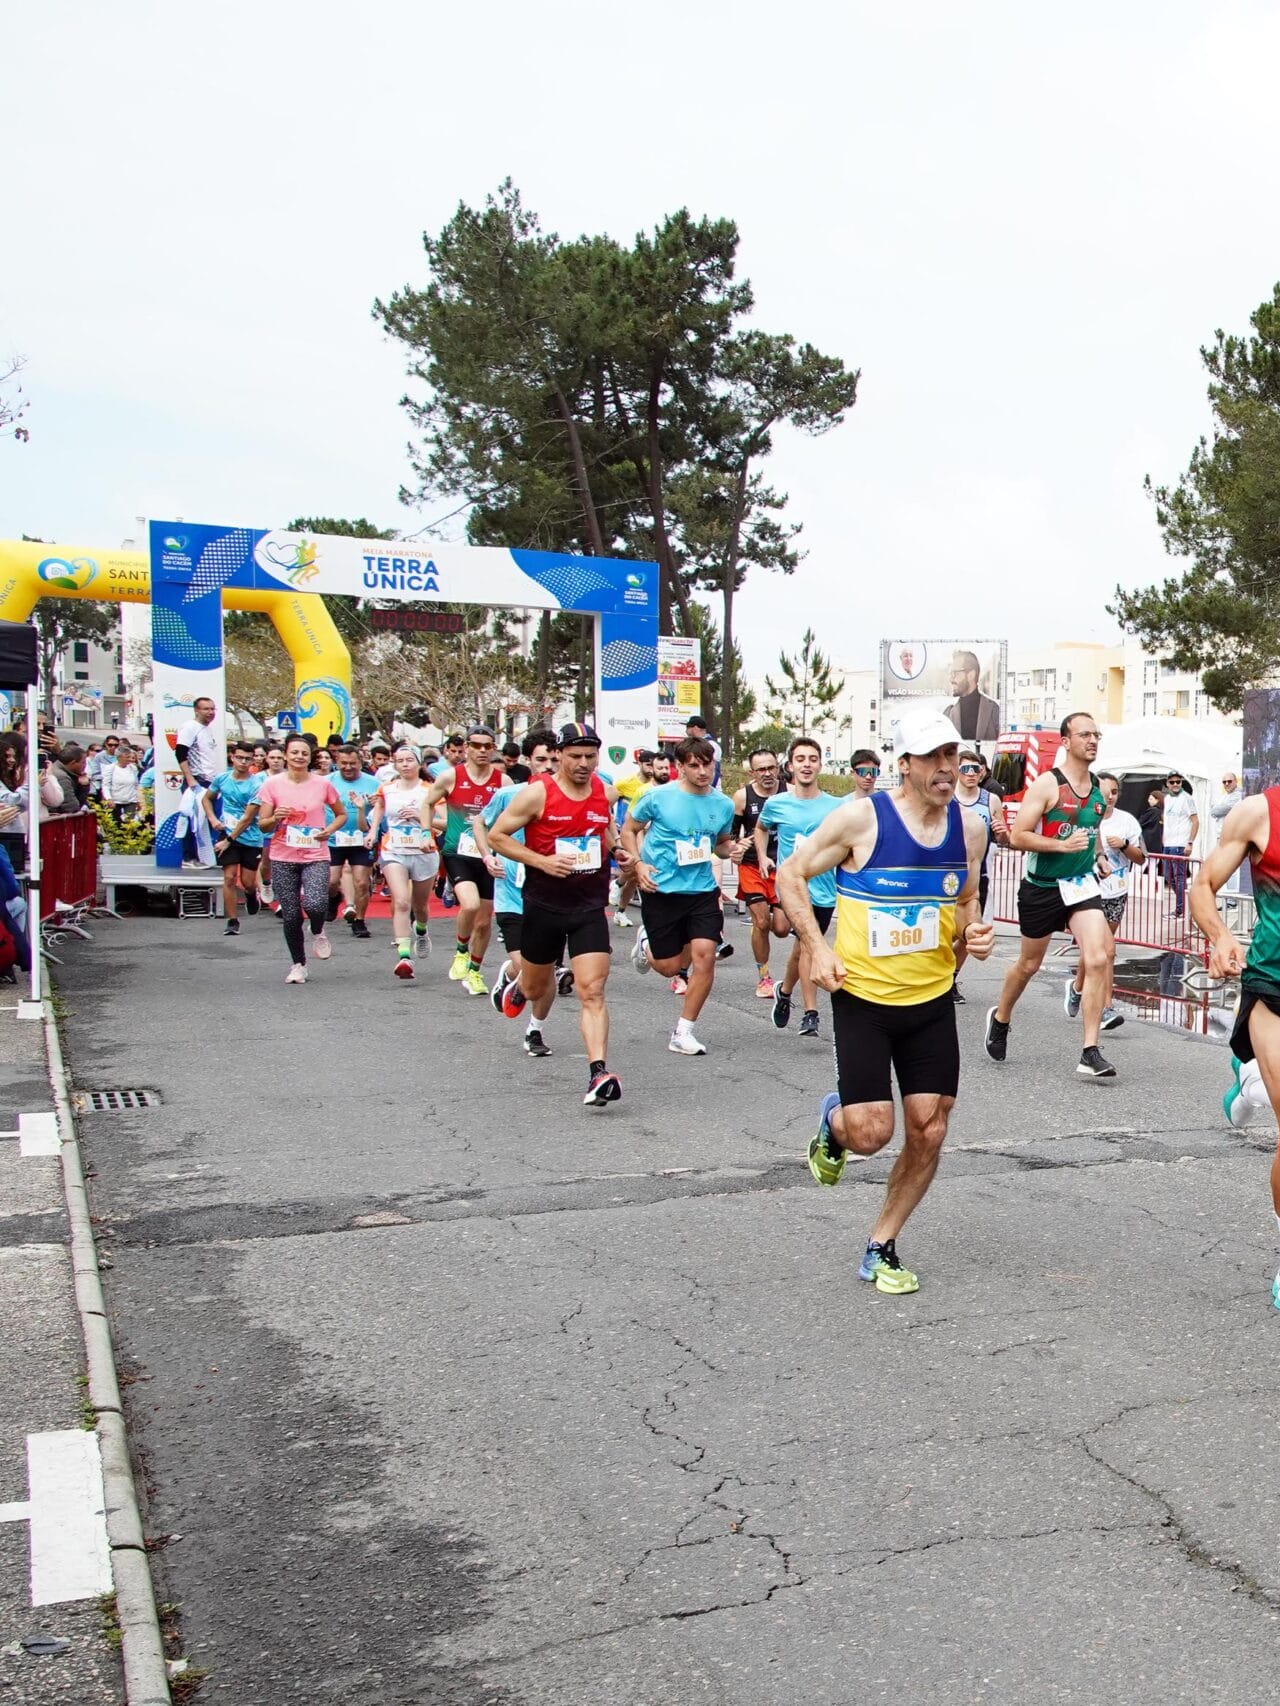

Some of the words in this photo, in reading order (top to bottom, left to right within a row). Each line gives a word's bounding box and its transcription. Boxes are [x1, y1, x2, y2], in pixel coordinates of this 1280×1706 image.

[108, 568, 149, 580] SANT
[362, 556, 440, 575] TERRA
[363, 571, 440, 592] ÚNICA
[890, 928, 923, 948] 360
